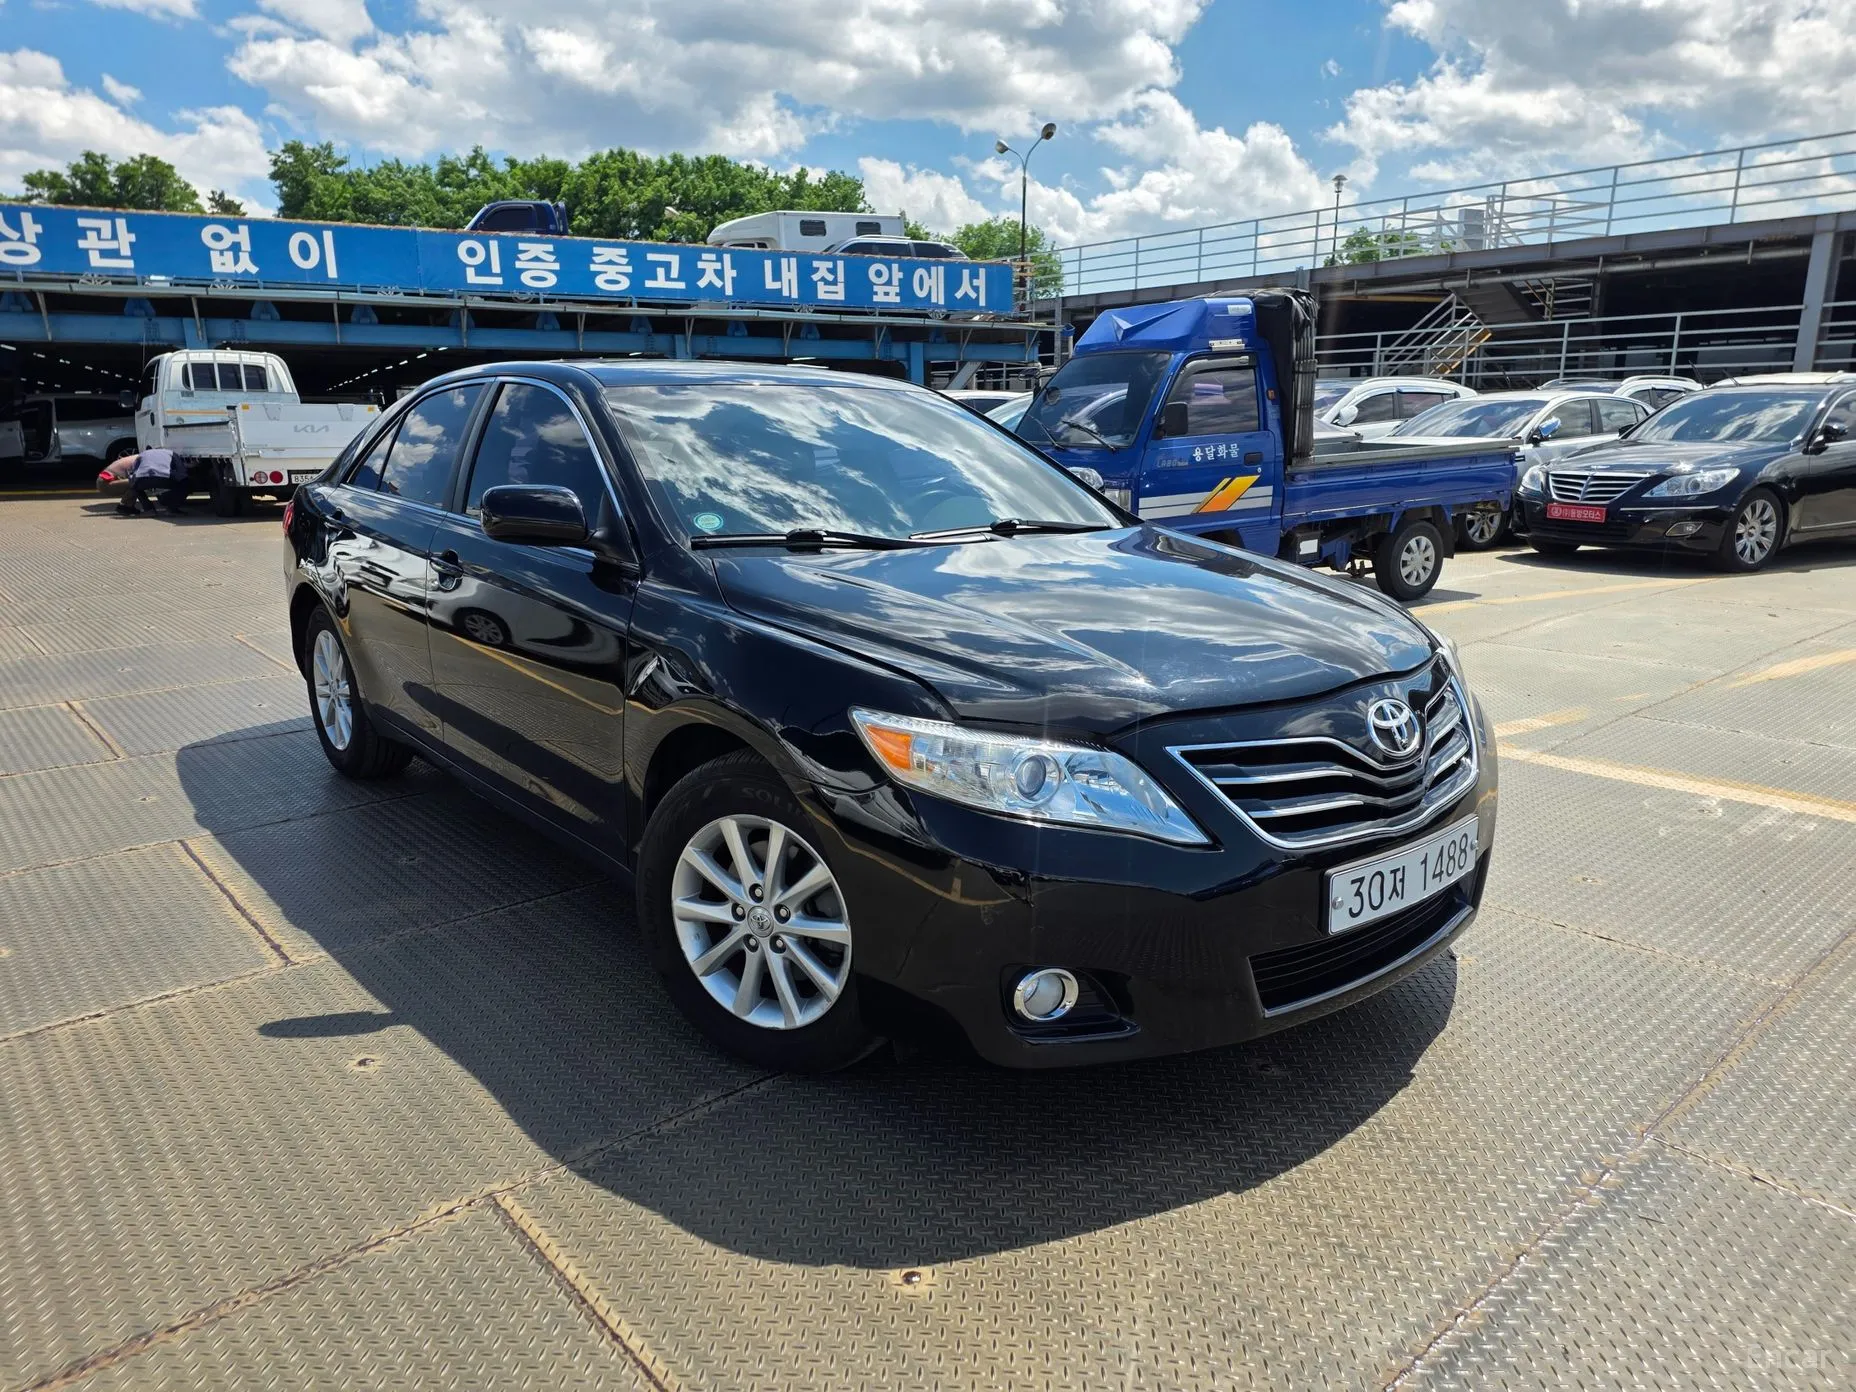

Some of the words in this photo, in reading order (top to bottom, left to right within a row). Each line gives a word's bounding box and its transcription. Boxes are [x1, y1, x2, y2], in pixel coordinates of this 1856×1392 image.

[0, 211, 136, 269] 상관
[201, 224, 338, 279] 없이
[458, 239, 560, 289] 인증
[590, 247, 736, 296] 중고차
[764, 257, 845, 301] 내집
[868, 262, 987, 307] 앞에서
[1192, 443, 1240, 462] 용달화물
[1348, 865, 1405, 918] 30저
[1420, 832, 1468, 891] 1488
